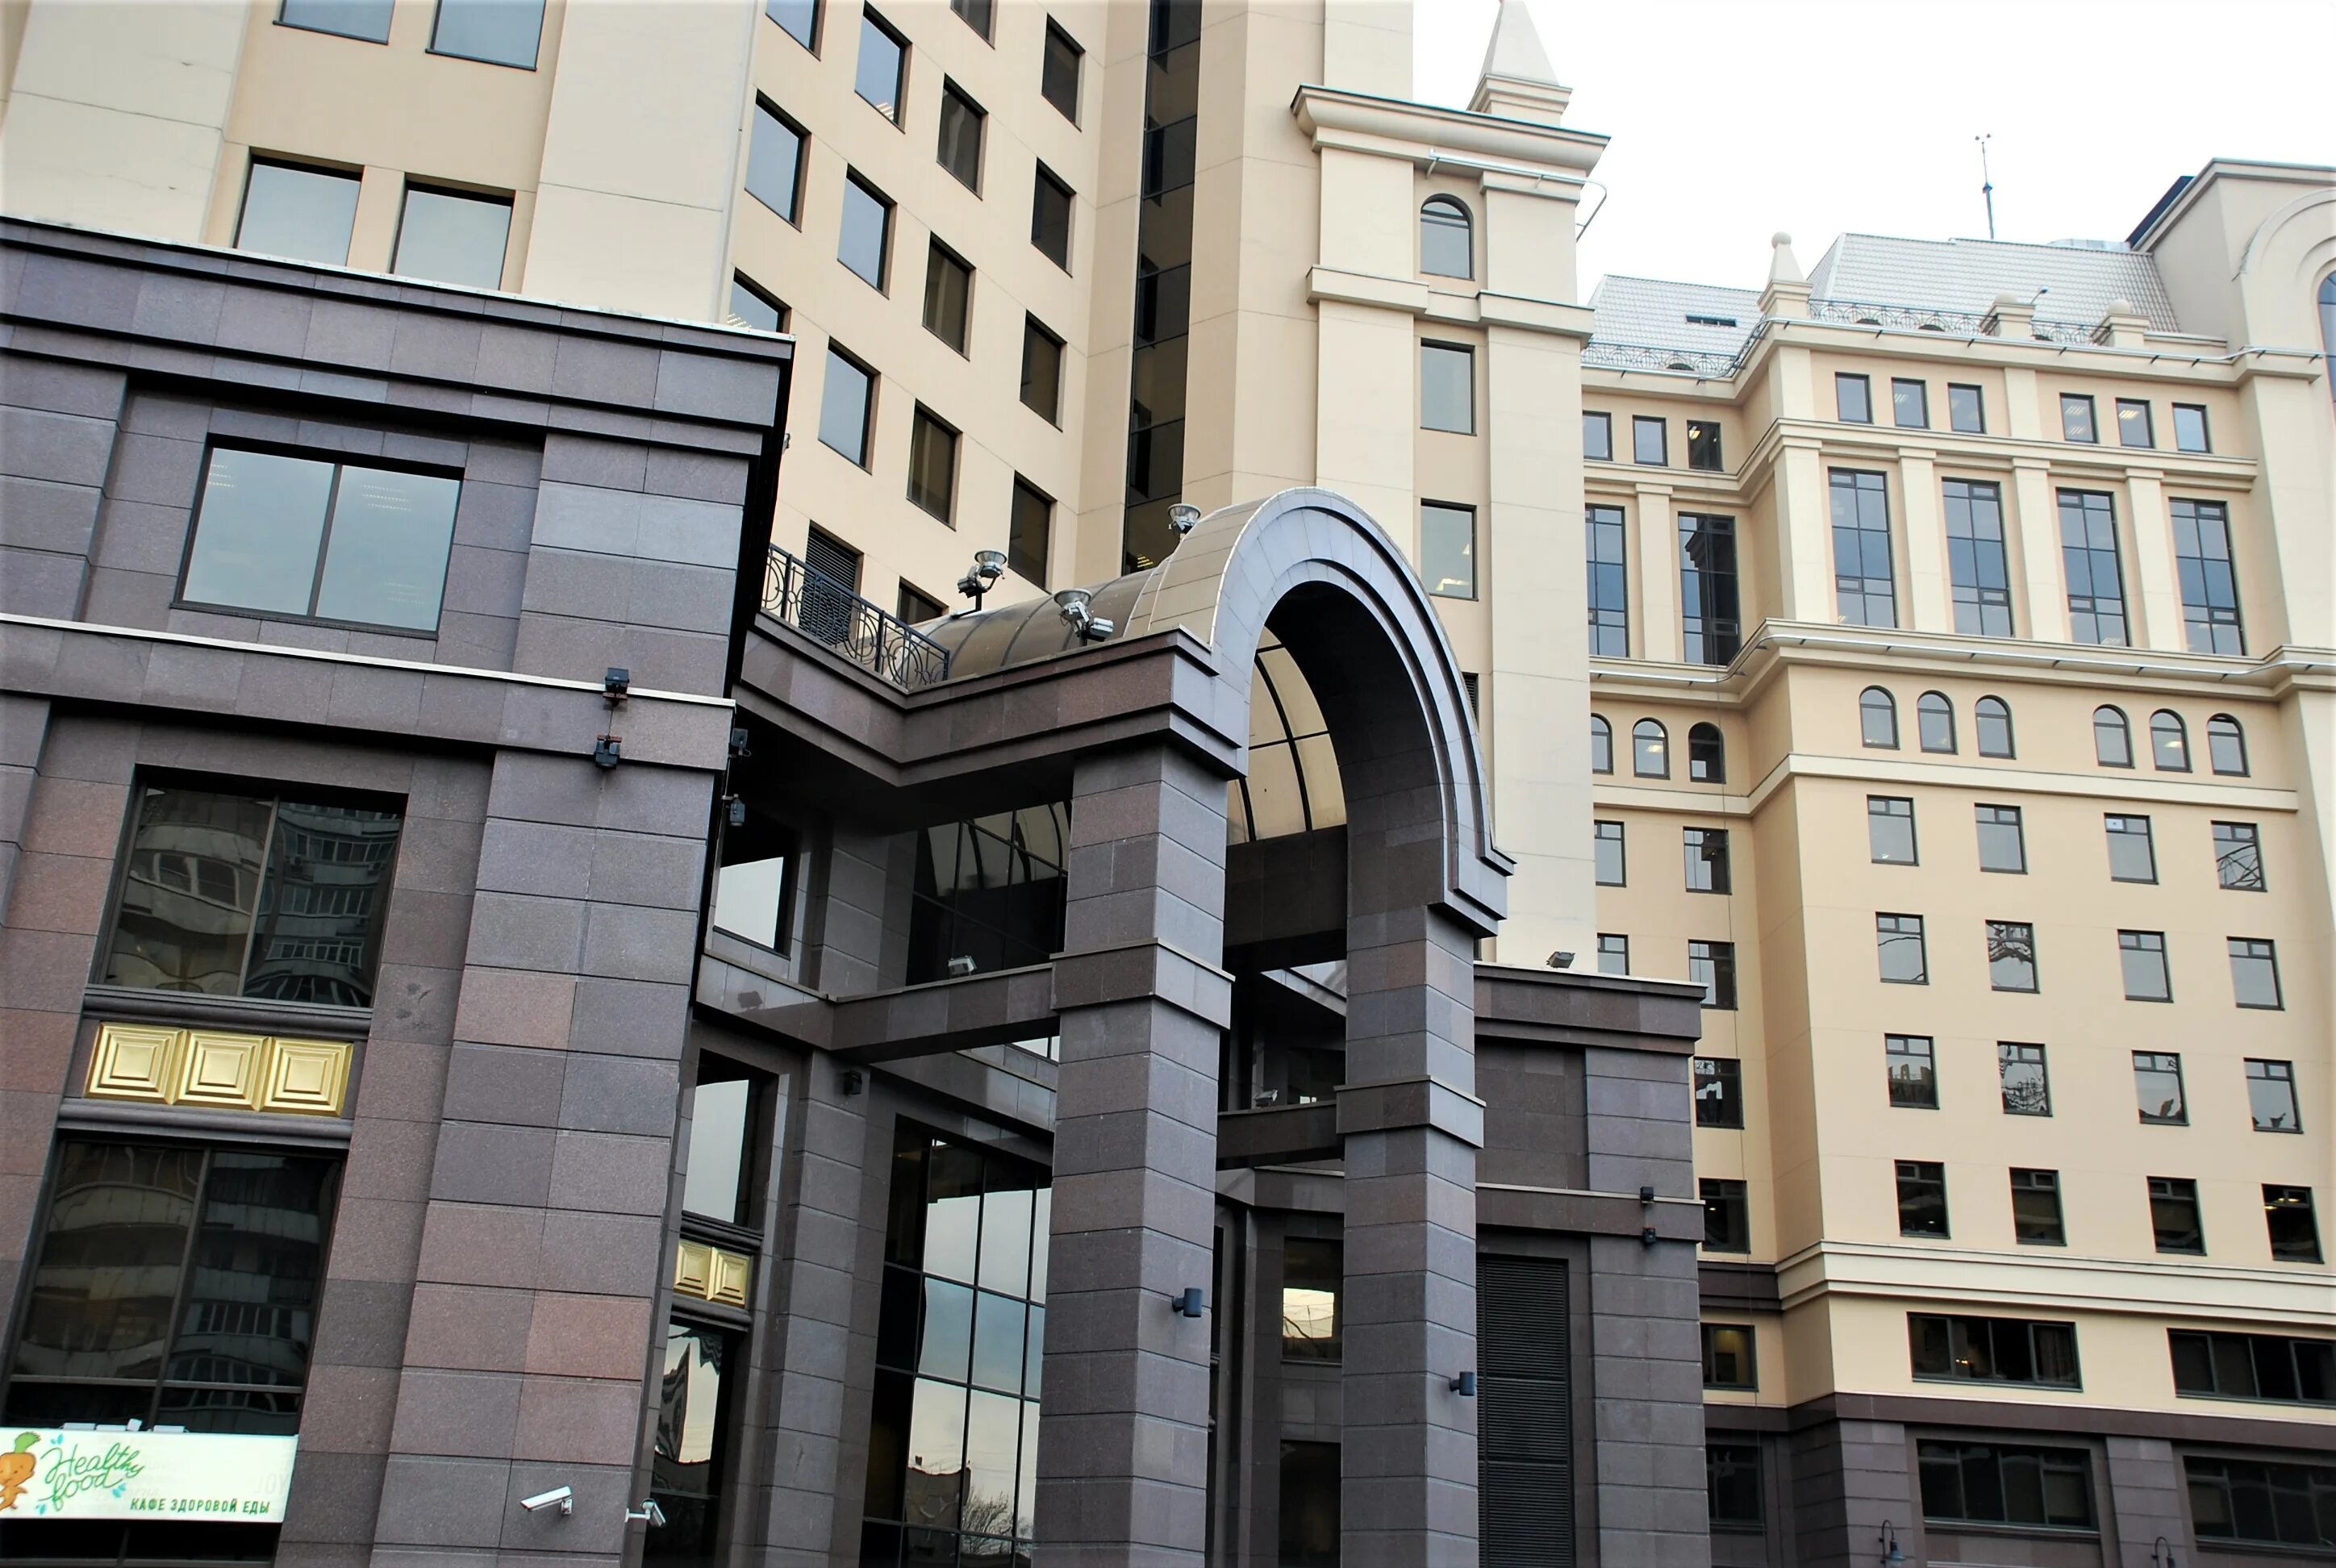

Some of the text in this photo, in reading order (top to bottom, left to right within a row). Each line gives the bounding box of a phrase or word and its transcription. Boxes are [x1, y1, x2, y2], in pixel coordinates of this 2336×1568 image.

[40, 1442, 145, 1484] Healthy
[38, 1473, 124, 1512] food
[130, 1498, 270, 1515] КАФЕ ЗДОРОВОЙ ЕДЫ
